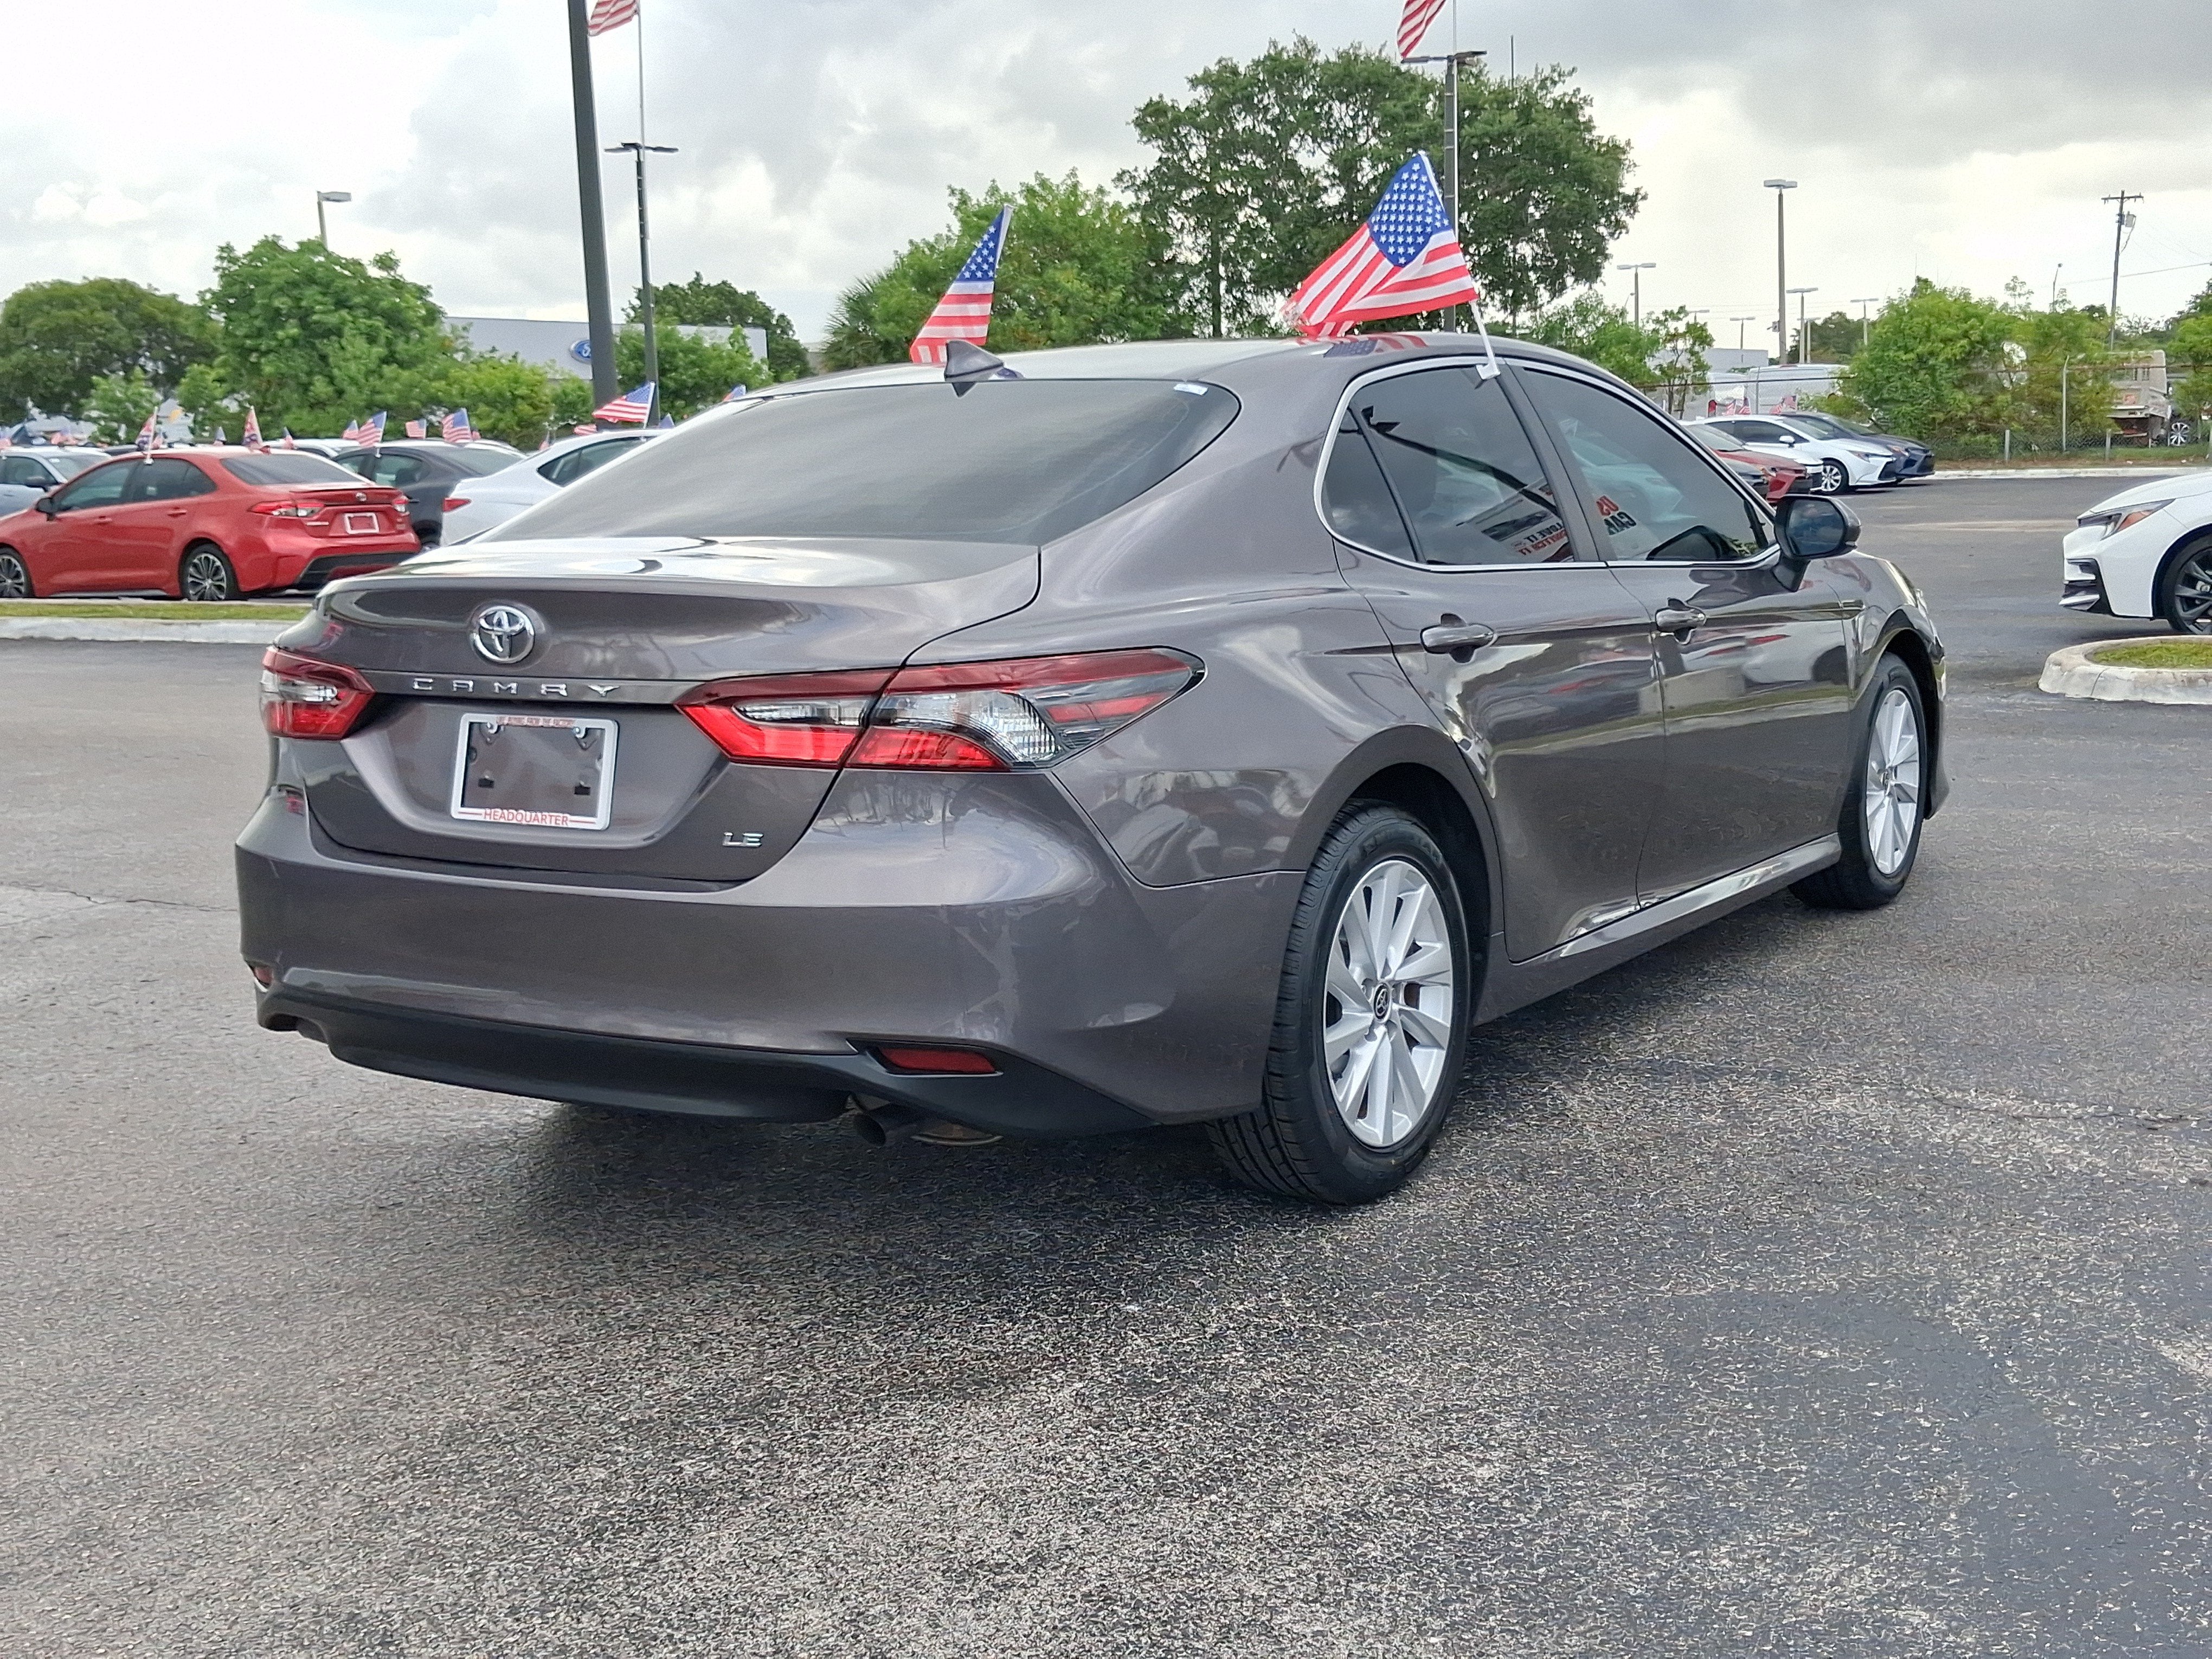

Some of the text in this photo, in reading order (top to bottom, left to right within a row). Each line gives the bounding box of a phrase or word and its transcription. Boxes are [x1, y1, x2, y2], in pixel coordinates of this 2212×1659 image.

[412, 678, 620, 697] CAMRY
[483, 808, 569, 826] HEADQUARTER
[722, 832, 764, 847] LE
